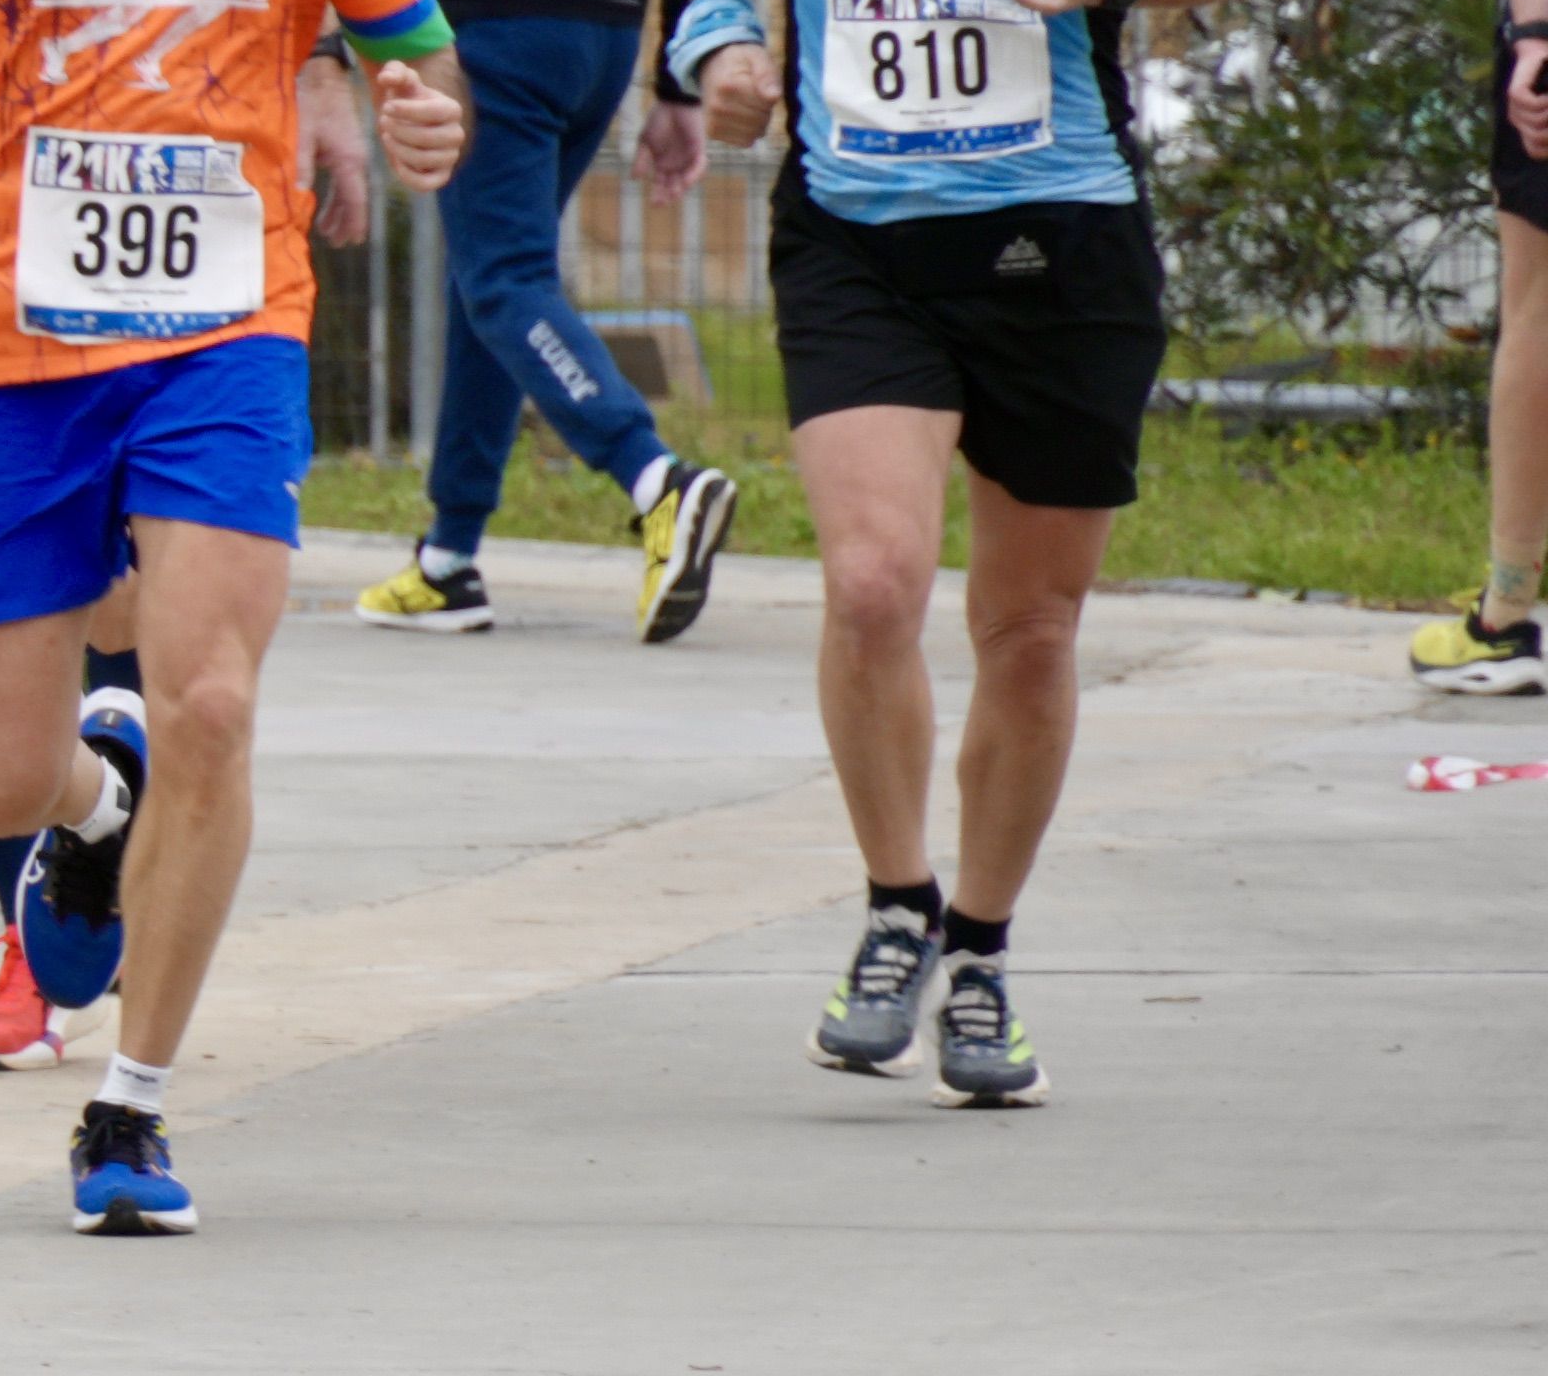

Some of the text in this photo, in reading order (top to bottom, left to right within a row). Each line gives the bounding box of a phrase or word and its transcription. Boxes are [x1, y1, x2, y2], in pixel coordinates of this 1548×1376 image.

[870, 25, 989, 101] 810
[57, 140, 133, 193] 21K
[73, 201, 199, 280] 396
